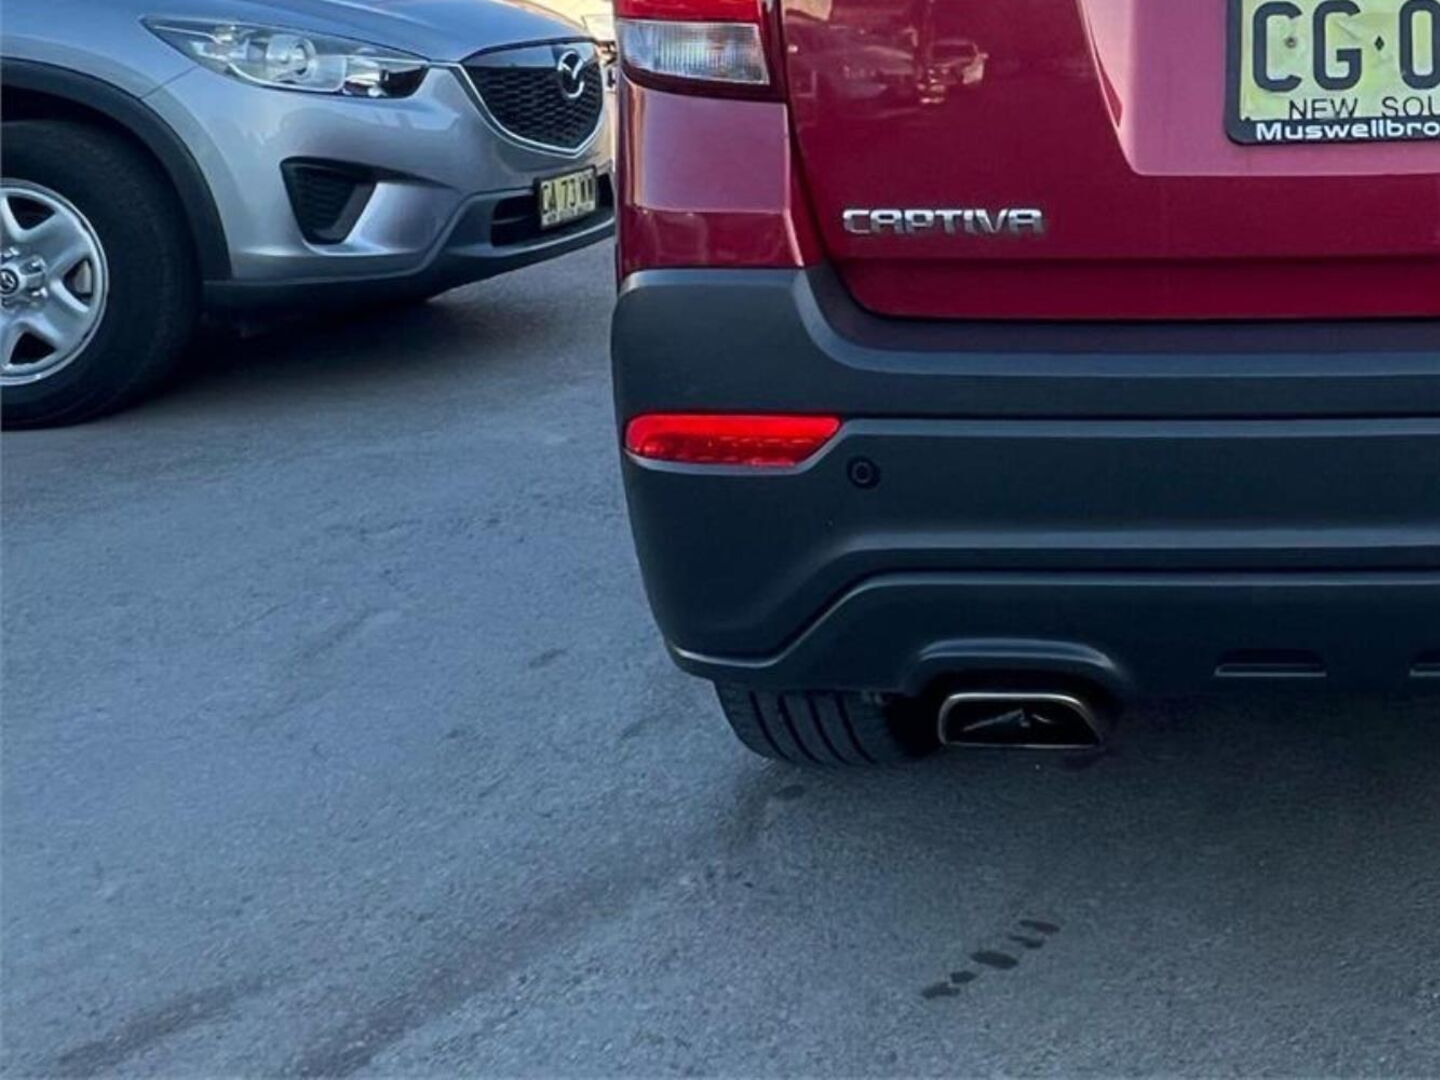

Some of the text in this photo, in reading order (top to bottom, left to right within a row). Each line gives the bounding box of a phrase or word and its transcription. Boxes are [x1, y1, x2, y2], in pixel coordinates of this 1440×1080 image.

[1252, 0, 1363, 92] CG
[1288, 98, 1359, 120] NEW
[842, 208, 1044, 235] CAPTIVA
